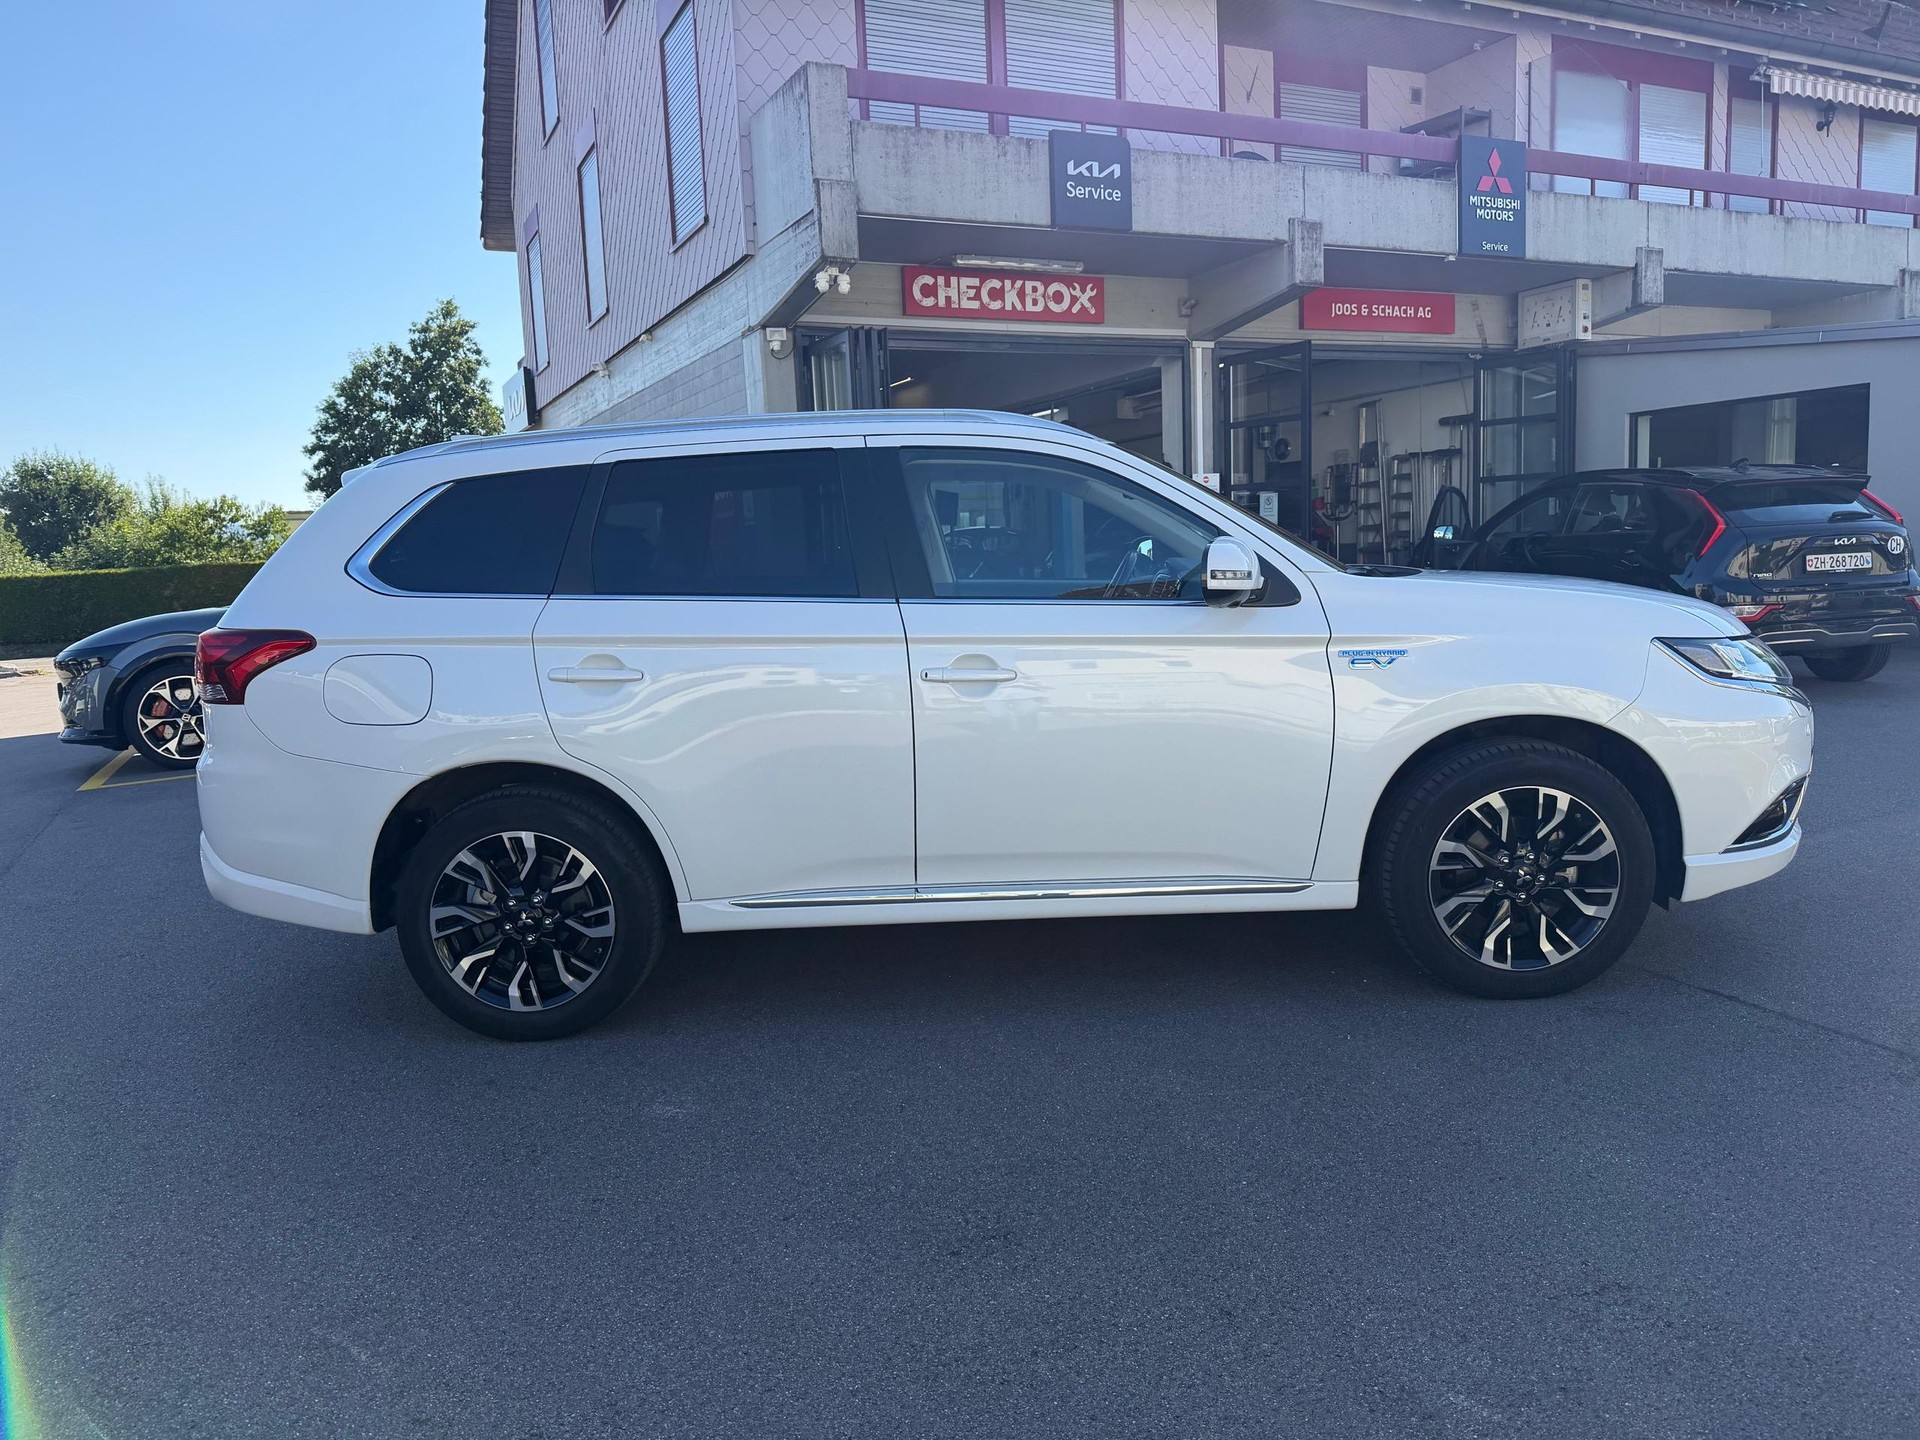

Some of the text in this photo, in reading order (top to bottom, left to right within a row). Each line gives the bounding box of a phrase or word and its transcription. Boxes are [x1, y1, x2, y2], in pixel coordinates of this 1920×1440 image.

[1066, 181, 1122, 202] Service
[1469, 195, 1521, 210] MITSUBISHI
[1476, 208, 1514, 222] MOTORS
[1482, 241, 1509, 252] Service
[912, 274, 1098, 315] CHECKBOX
[1331, 303, 1432, 319] JOOS & SCHACH AG
[1890, 538, 1903, 552] CH
[1375, 649, 1406, 657] HYBRID
